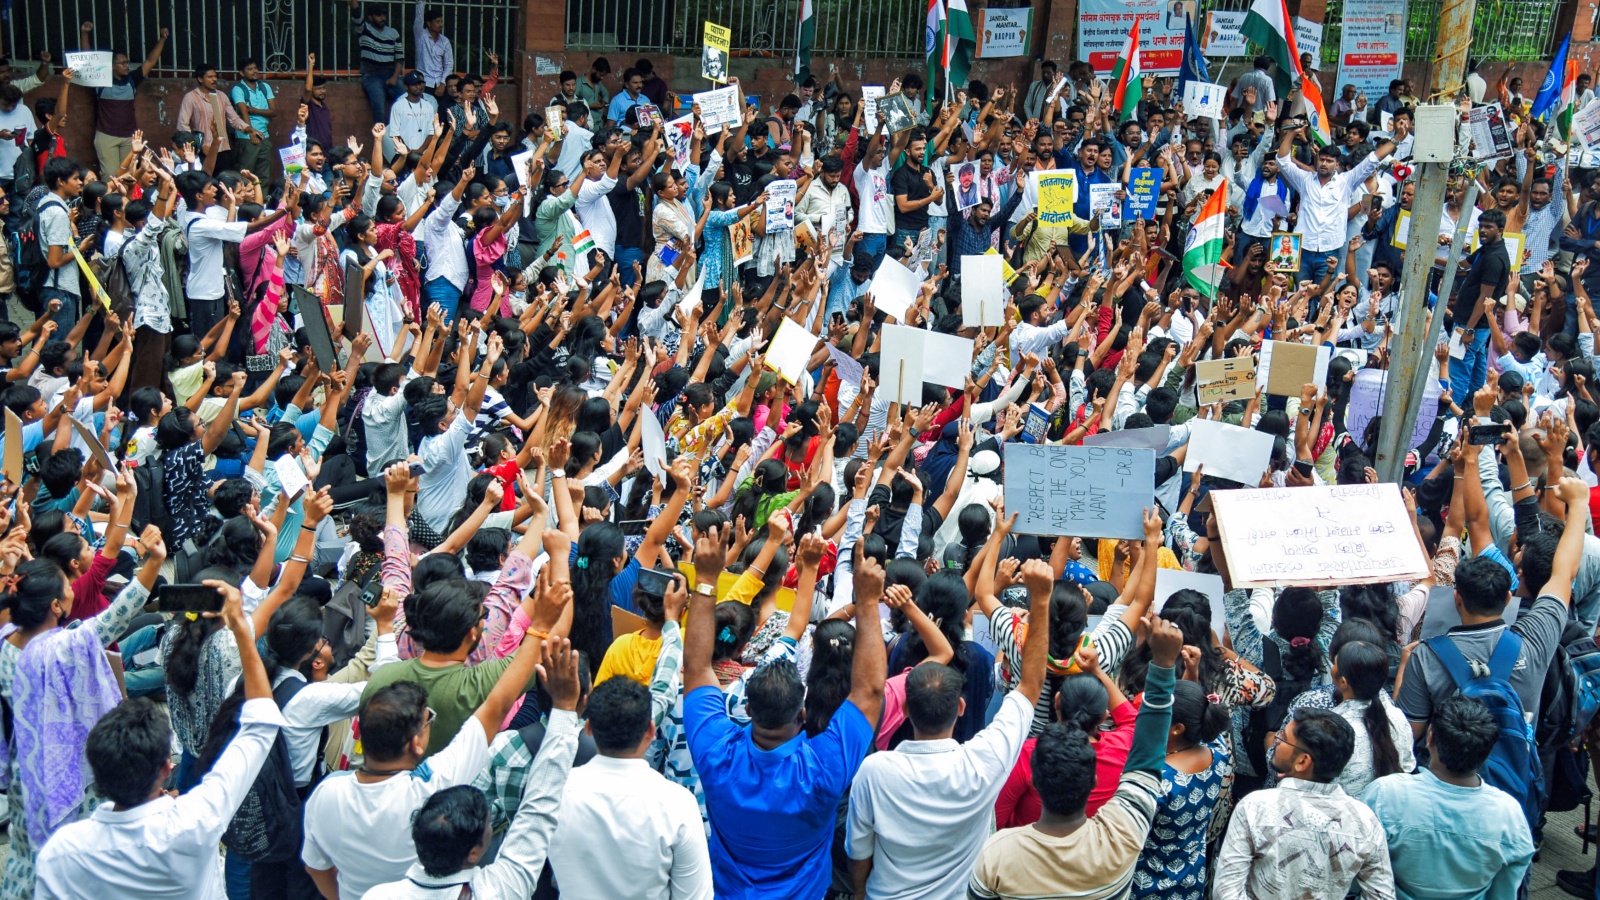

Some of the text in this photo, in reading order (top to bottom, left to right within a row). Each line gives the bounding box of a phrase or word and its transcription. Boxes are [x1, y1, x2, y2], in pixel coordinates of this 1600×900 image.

[994, 32, 1016, 40] NAGPUR
[1294, 24, 1312, 34] JANTAR
[1297, 41, 1316, 52] NAGPUR
[1050, 478, 1067, 498] THE
[1069, 457, 1086, 520] MAKE YOU
[1088, 447, 1107, 520] WANT TO
[1052, 507, 1068, 530] ARE
